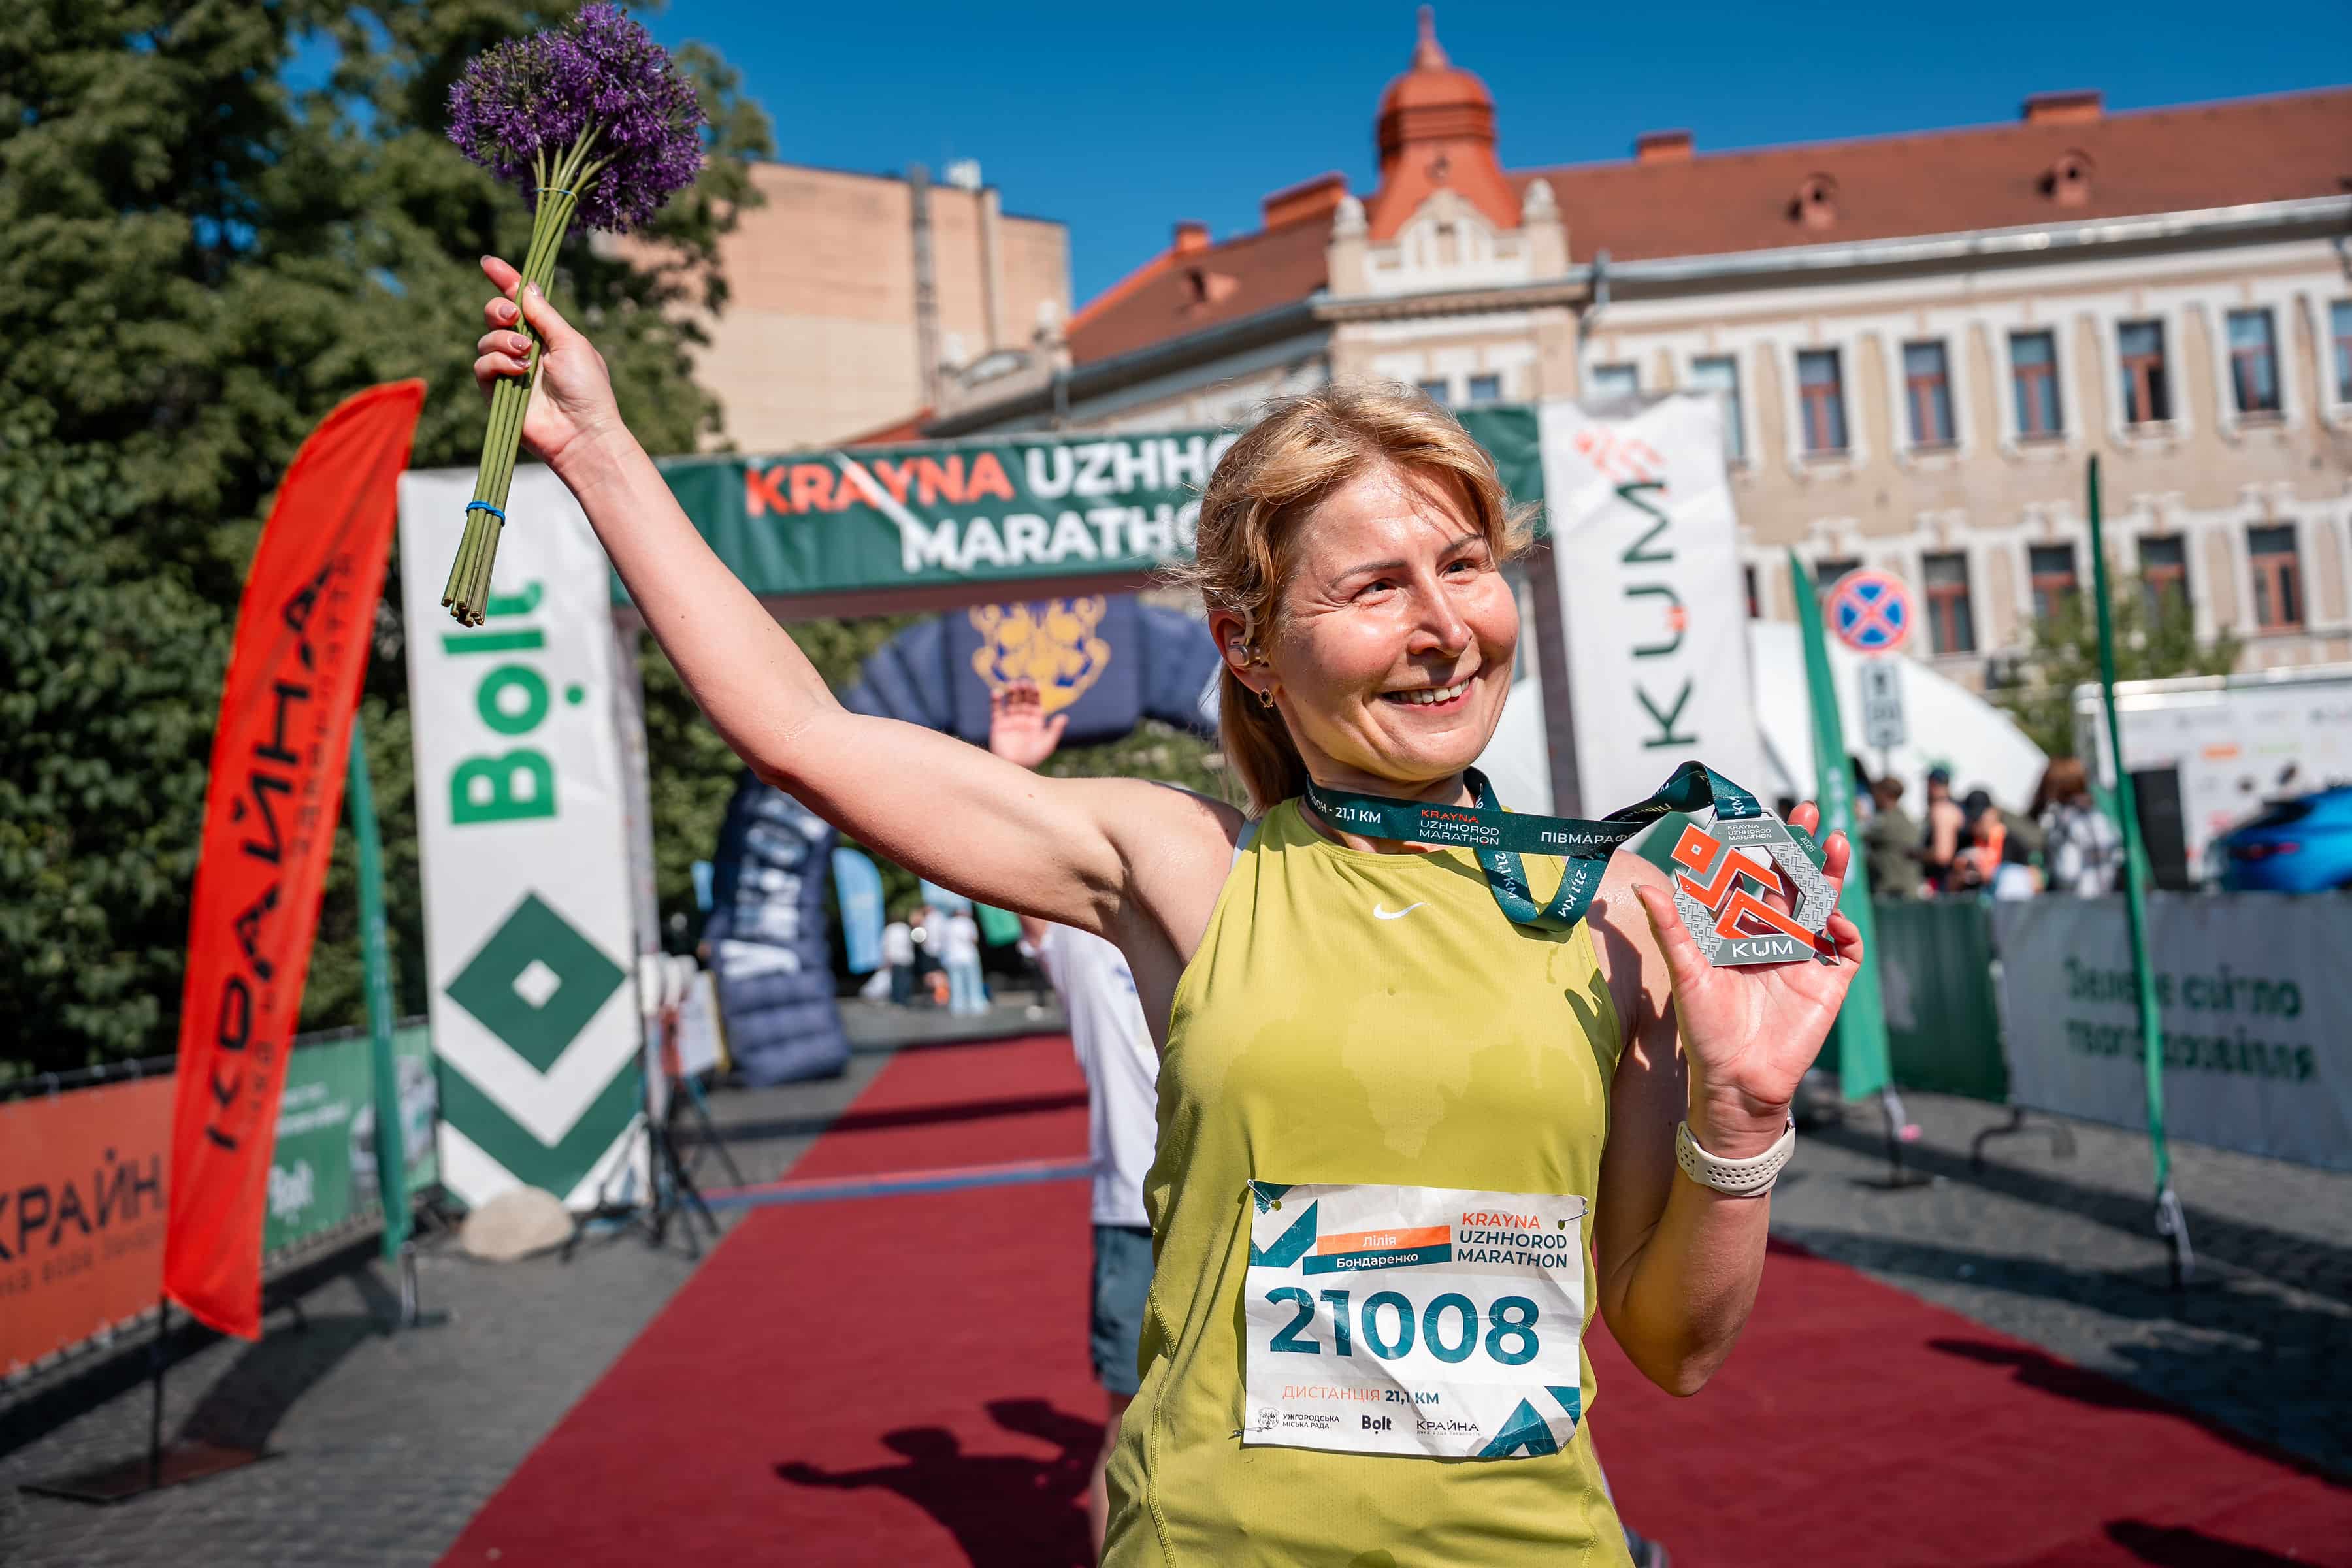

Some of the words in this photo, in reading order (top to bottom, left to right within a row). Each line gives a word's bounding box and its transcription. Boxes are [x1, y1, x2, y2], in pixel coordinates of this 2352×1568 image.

[745, 451, 1017, 517] KRAYNA
[1335, 807, 1355, 821] 21,1
[1421, 809, 1480, 824] KRAYNA
[1420, 819, 1499, 836] UZHHOROD
[1419, 829, 1499, 845] MARATHON
[1799, 835, 1814, 853] 2026
[1494, 852, 1511, 875] 21,1
[1571, 869, 1588, 894] 21,1
[1732, 940, 1793, 958] KUM
[0, 1148, 165, 1262] РАЙН
[1462, 1212, 1541, 1230] KRAYNA
[1362, 1234, 1397, 1248] Лілія
[1459, 1230, 1567, 1249] UZHHOROD
[1337, 1252, 1419, 1269] Бондаренко
[1457, 1249, 1567, 1269] MARATHON
[1265, 1286, 1539, 1365] 21008
[1282, 1385, 1380, 1403] ДИСТАНЦІЯ
[1384, 1390, 1411, 1405] 21,1
[1282, 1413, 1340, 1422] УЖГОРОДСЬКА
[1362, 1414, 1392, 1435] Bolt
[1416, 1419, 1479, 1432] КРАЙНА
